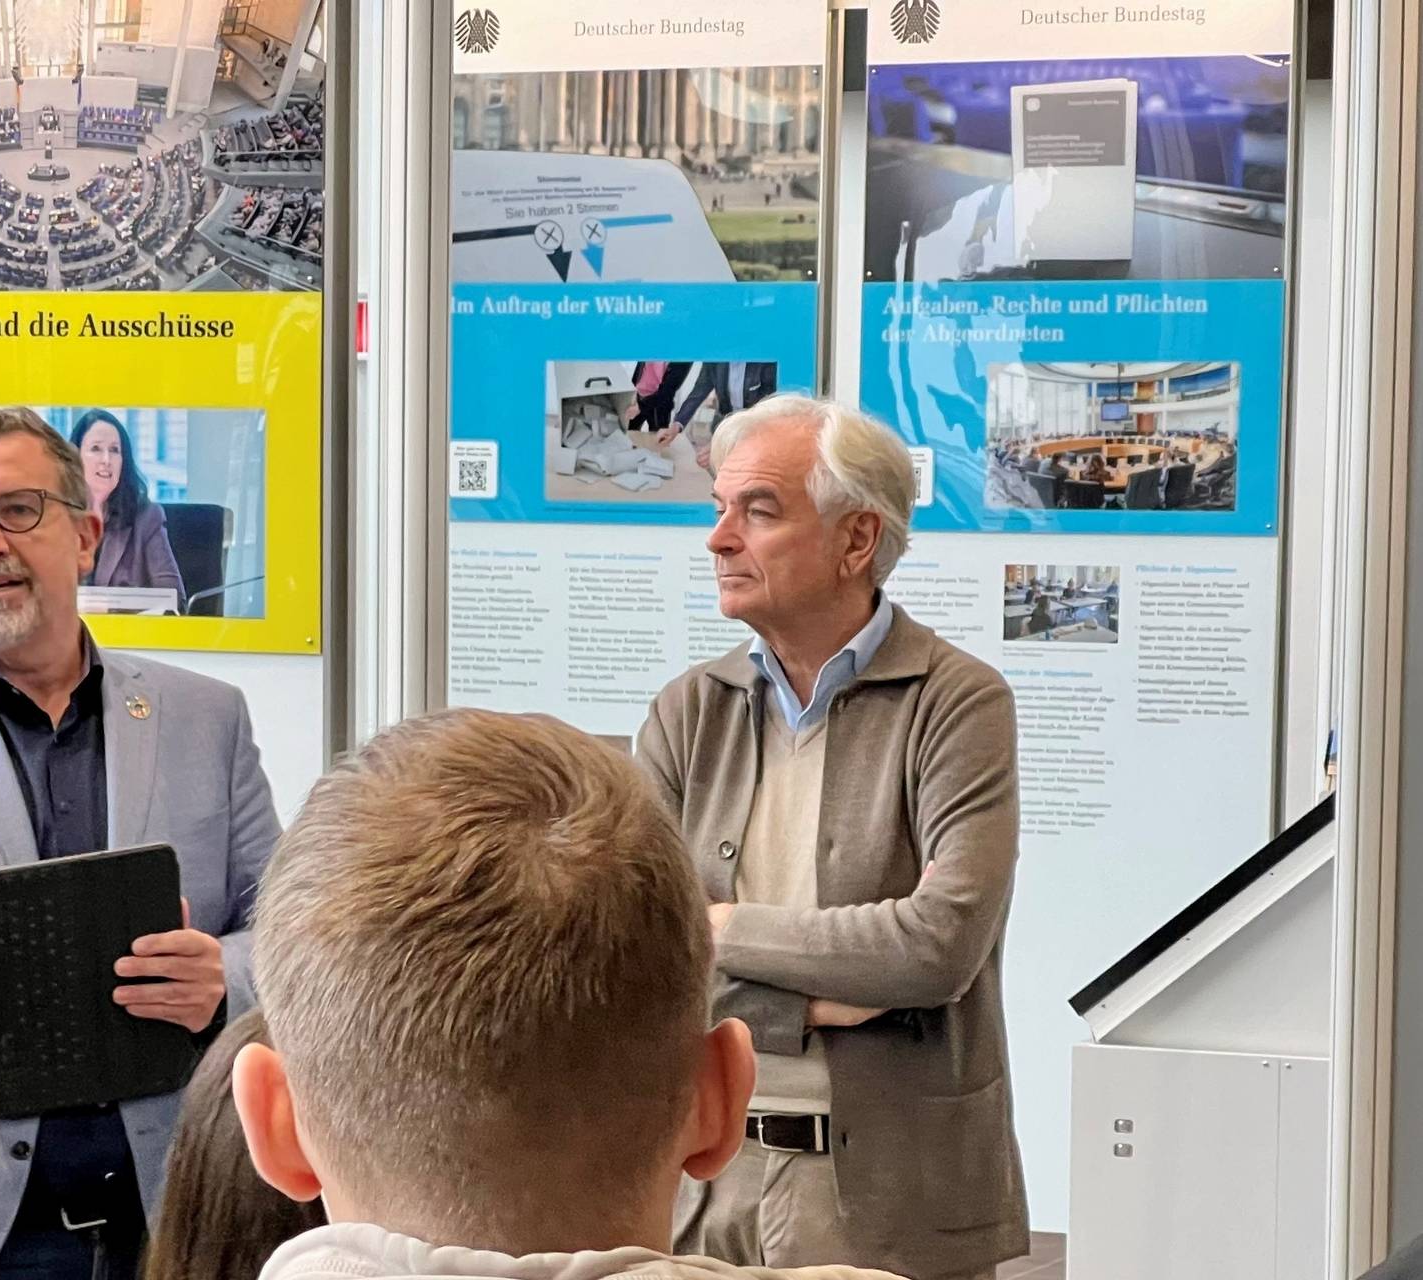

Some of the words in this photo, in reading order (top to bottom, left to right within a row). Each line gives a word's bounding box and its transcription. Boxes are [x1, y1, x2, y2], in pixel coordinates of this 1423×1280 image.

[1021, 6, 1109, 25] Deutscher
[1114, 4, 1207, 26] Bundestag
[574, 20, 655, 37] Deutscher
[660, 17, 745, 38] Bundestag
[567, 204, 574, 215] 2
[481, 295, 552, 320] Auftrag
[557, 295, 589, 314] der
[595, 295, 665, 314] Wähler
[882, 296, 985, 317] Aufgaben,
[990, 294, 1062, 314] Rechte
[1068, 294, 1108, 314] und
[1116, 293, 1208, 314] Pflichten
[29, 311, 70, 337] die
[78, 312, 235, 338] Ausschüsse
[881, 326, 913, 342] der
[924, 325, 1065, 344] Abgeordneten
